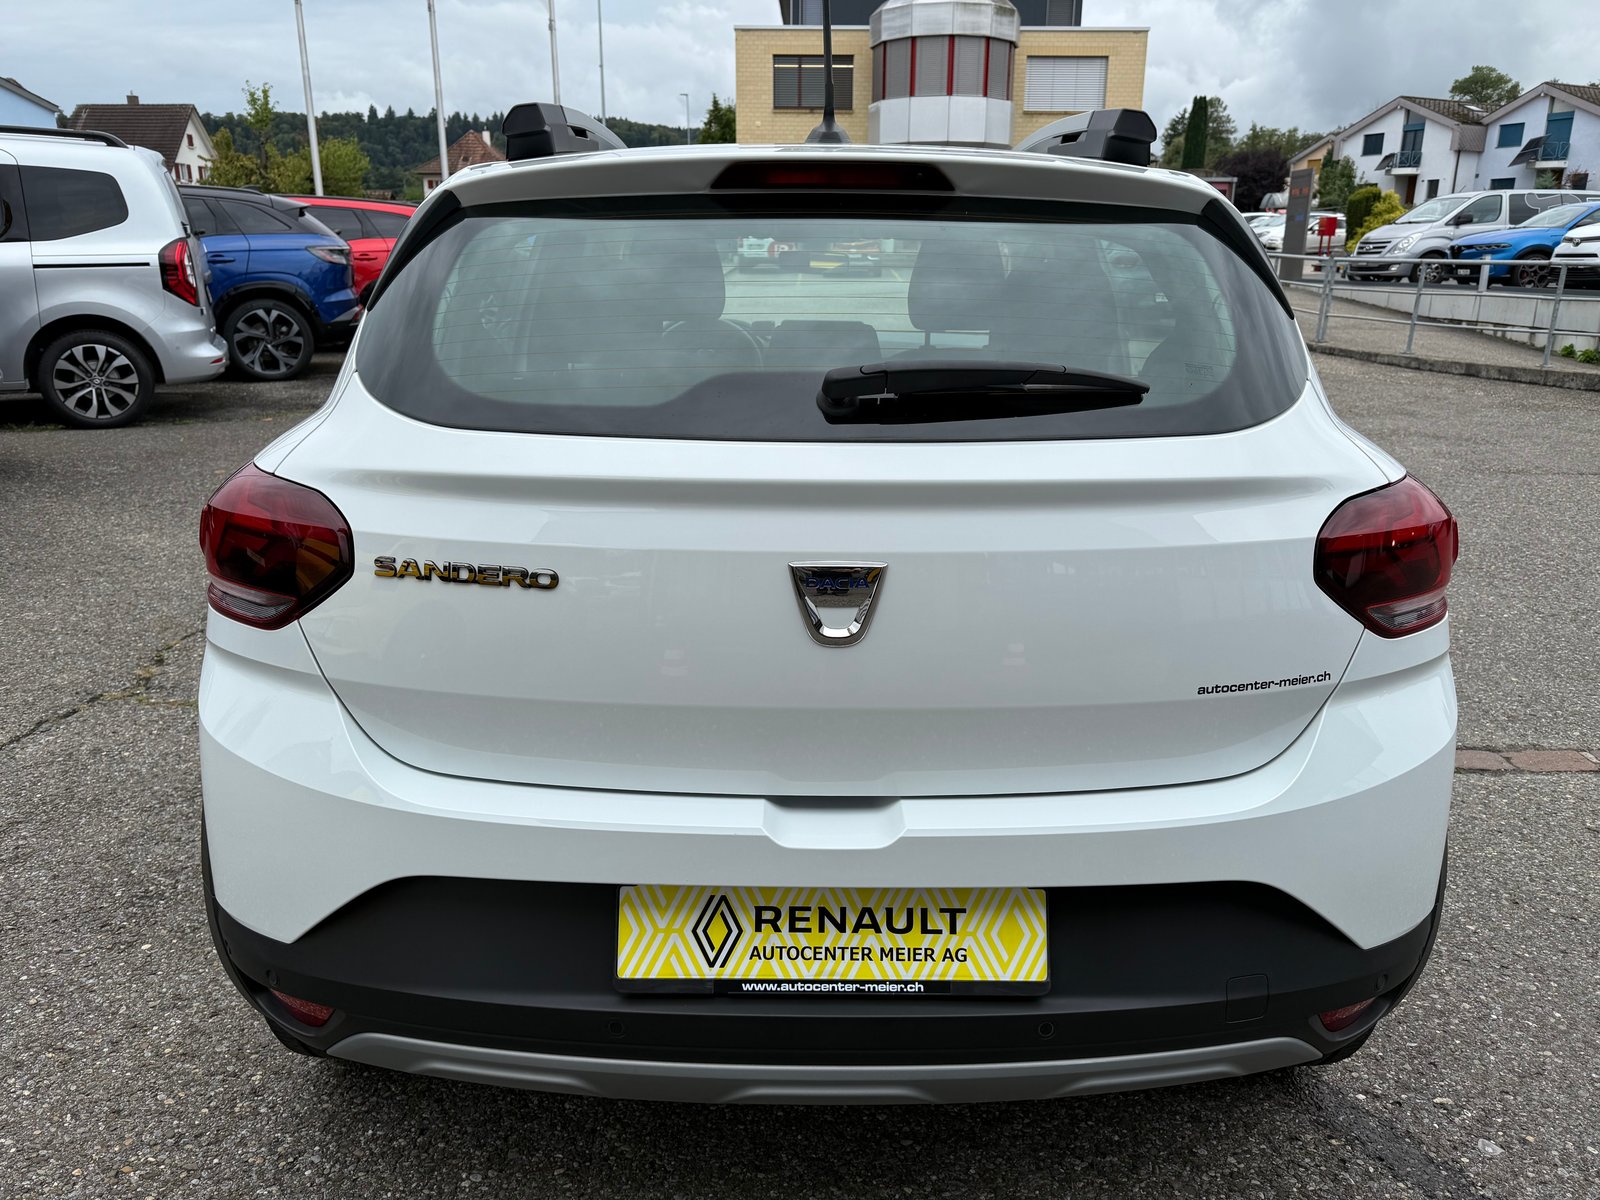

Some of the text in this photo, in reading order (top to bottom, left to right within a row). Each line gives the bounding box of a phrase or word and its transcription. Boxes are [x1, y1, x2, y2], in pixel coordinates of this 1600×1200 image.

[374, 555, 560, 590] SANDERO
[805, 576, 870, 589] DACIA
[1197, 670, 1331, 695] autocenter-meier.ch
[754, 905, 967, 935] RENAULT
[749, 946, 968, 963] AUTOCENTER MEIER AG
[741, 981, 924, 993] www.autocenter-meier.ch
